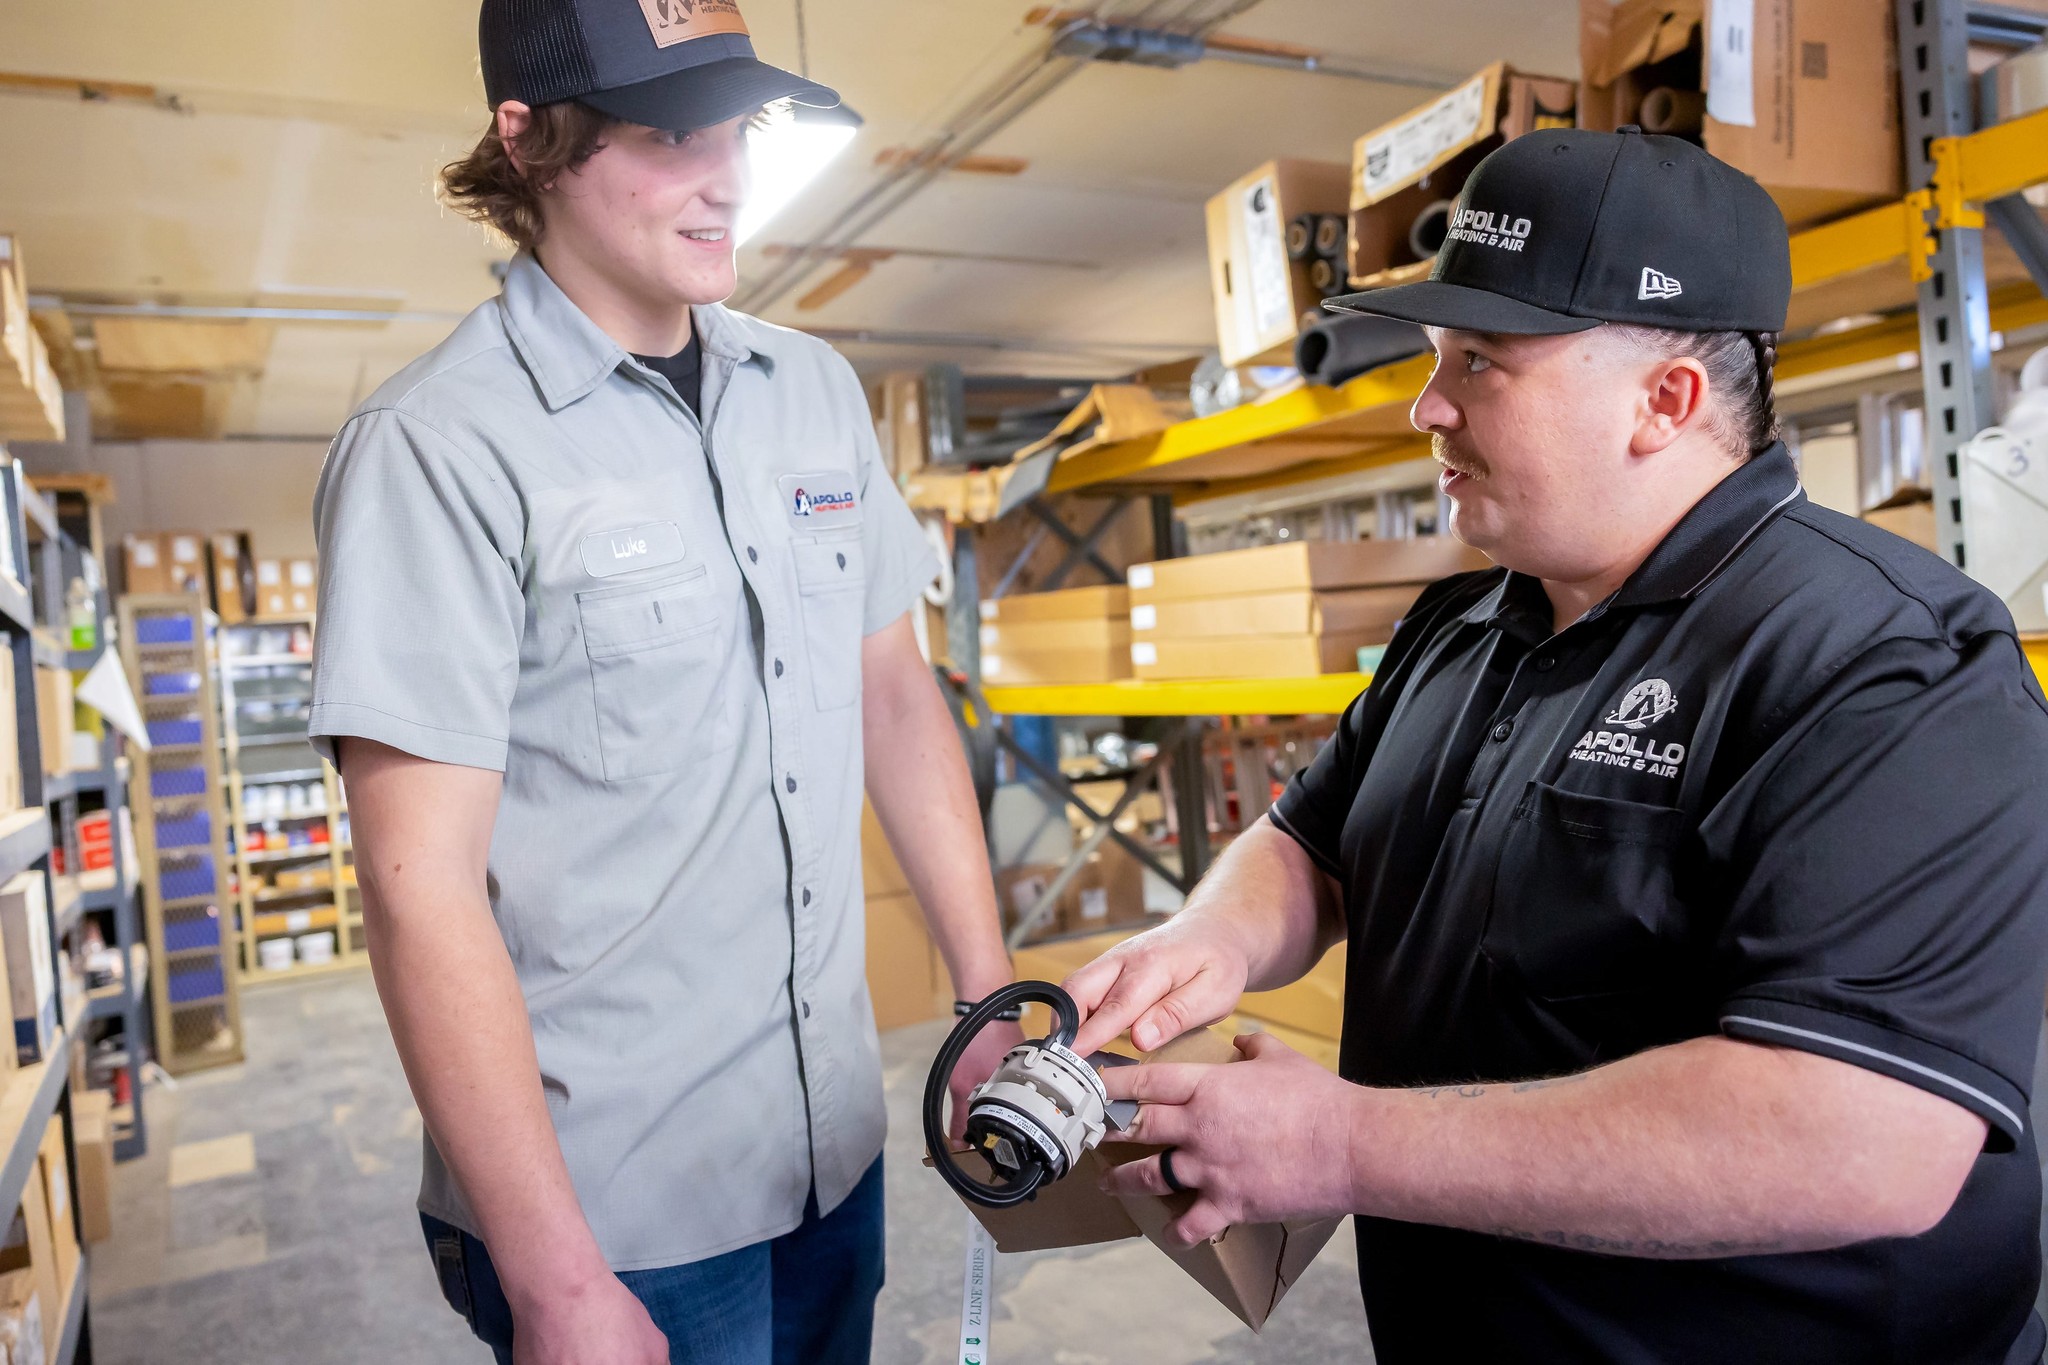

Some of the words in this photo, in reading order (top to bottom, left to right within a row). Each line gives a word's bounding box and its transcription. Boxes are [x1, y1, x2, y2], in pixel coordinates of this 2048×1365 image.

[1453, 208, 1532, 239] APOLLO
[1449, 228, 1488, 244] HEATING
[1488, 235, 1499, 246] &
[1498, 237, 1525, 252] AIR
[813, 492, 853, 504] APOLLO
[611, 535, 648, 559] Luke
[1574, 731, 1685, 765] APOLLO
[1569, 749, 1630, 768] HEATING
[1632, 759, 1646, 771] &
[1647, 763, 1679, 778] AIR
[972, 1247, 984, 1286] SERIES
[969, 1289, 983, 1326] Z-LINE
